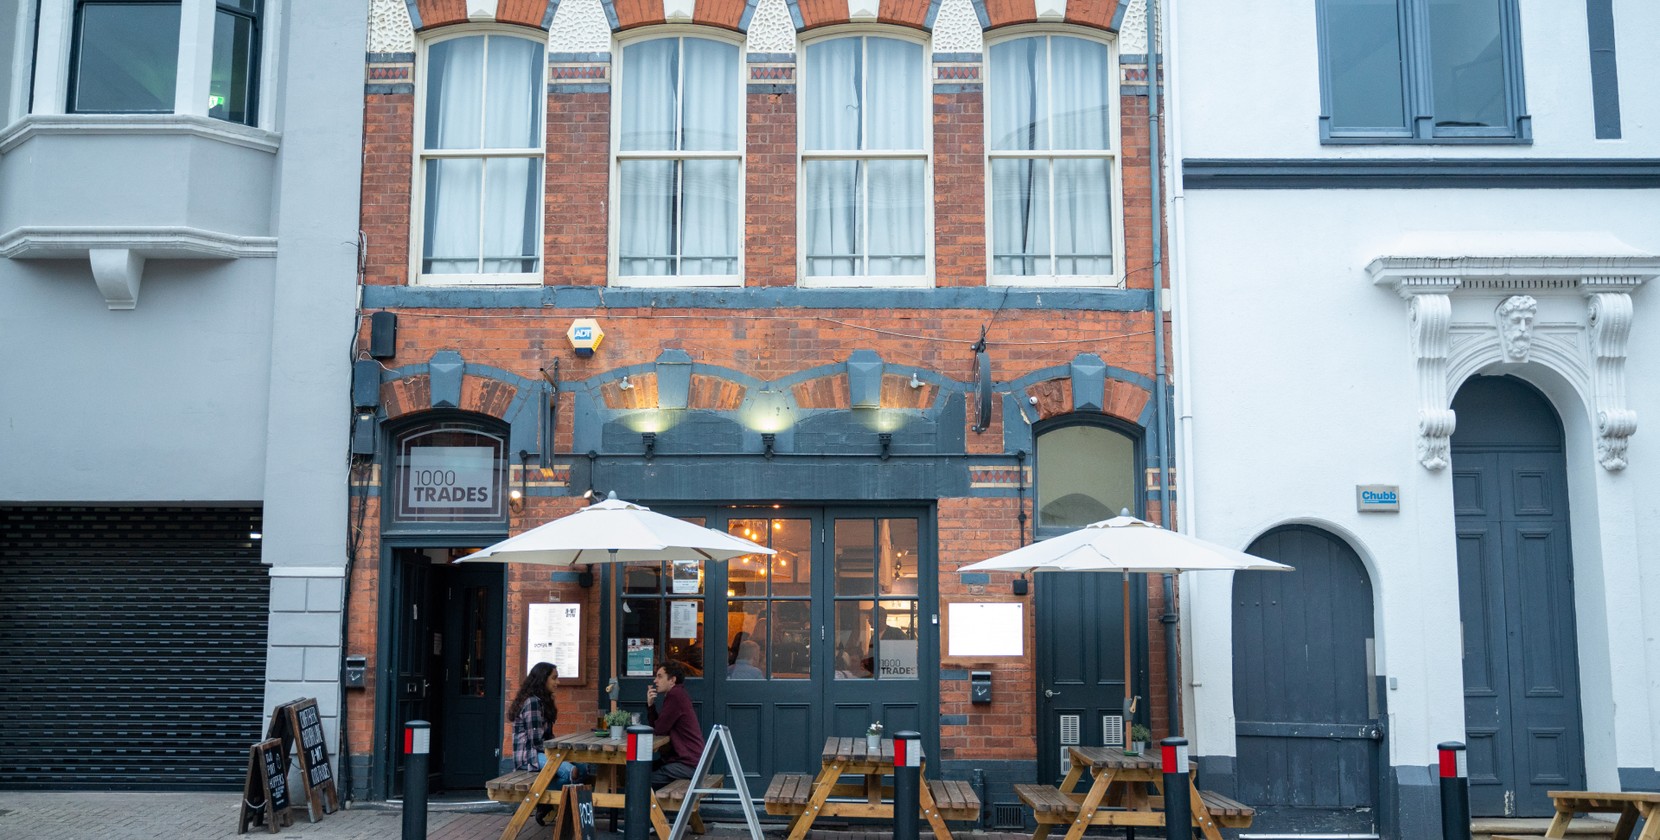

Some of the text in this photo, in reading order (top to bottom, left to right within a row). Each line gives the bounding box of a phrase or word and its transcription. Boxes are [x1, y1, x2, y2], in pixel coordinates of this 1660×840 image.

[574, 329, 592, 338] ADT
[415, 470, 456, 486] 1000
[413, 486, 488, 502] TRADES
[1362, 491, 1397, 500] Chubb
[881, 658, 901, 667] 1000
[881, 667, 916, 675] TRADES
